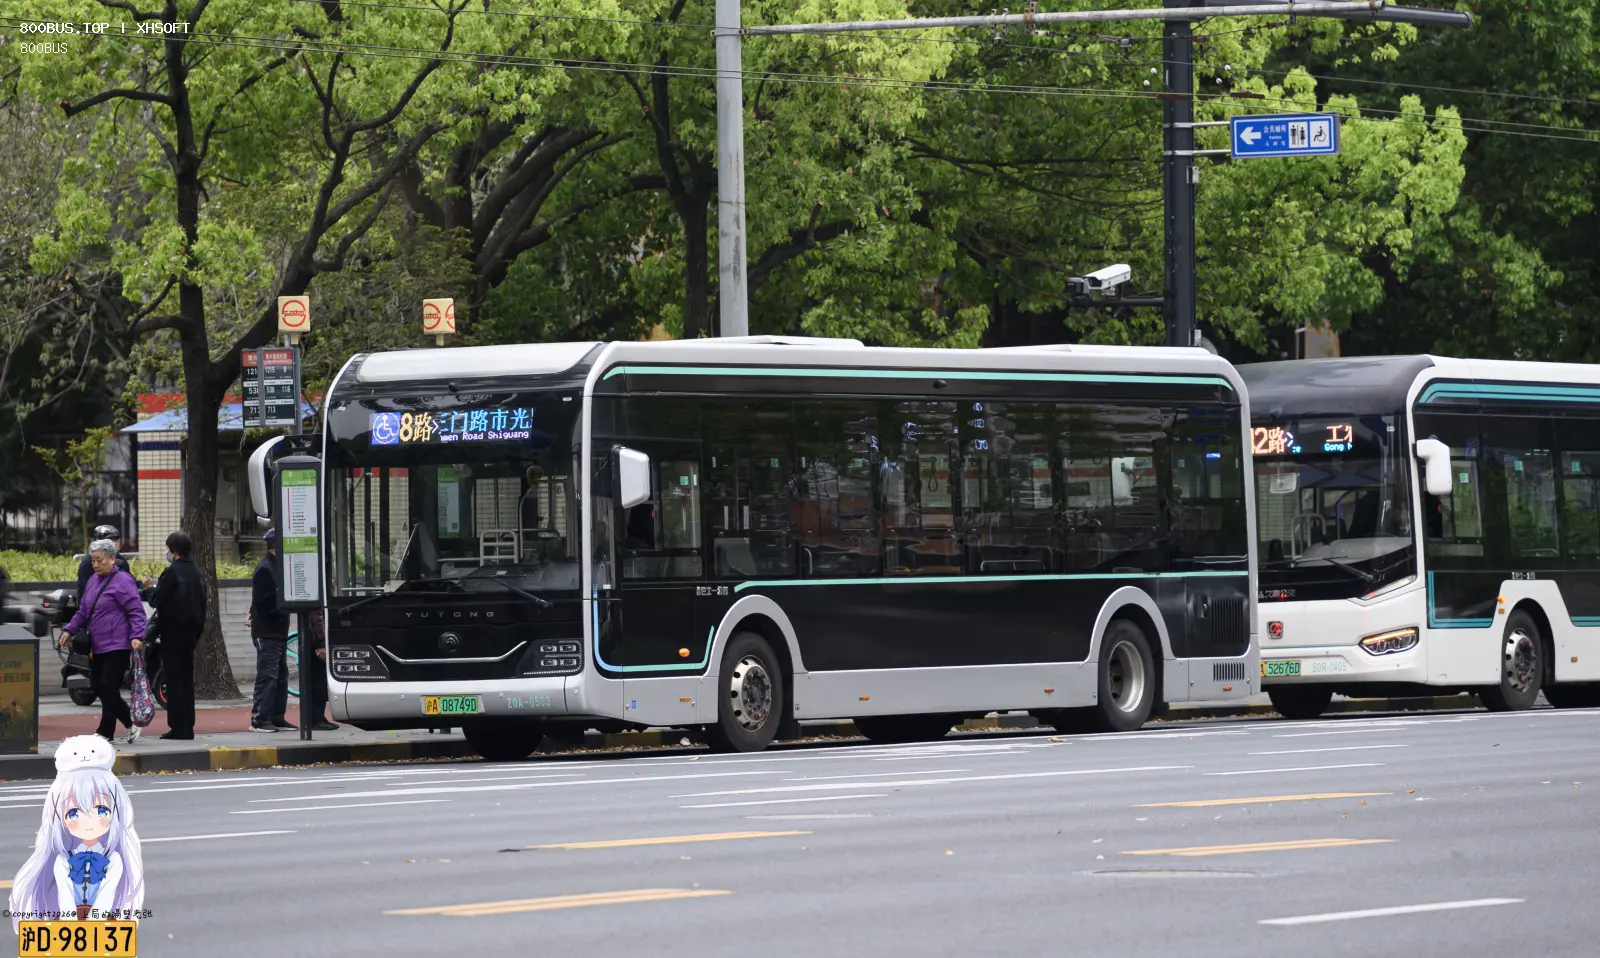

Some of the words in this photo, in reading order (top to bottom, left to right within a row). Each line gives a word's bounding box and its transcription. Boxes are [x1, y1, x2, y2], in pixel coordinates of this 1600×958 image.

[281, 385, 291, 393] 118
[267, 405, 276, 413] 713
[440, 407, 534, 433] 门路市光
[400, 411, 433, 442] 8路
[462, 431, 483, 441] Road
[488, 430, 530, 440] Shiguang
[1324, 442, 1344, 452] Gong
[1268, 662, 1300, 675] 52676D
[442, 698, 477, 712] 08749D
